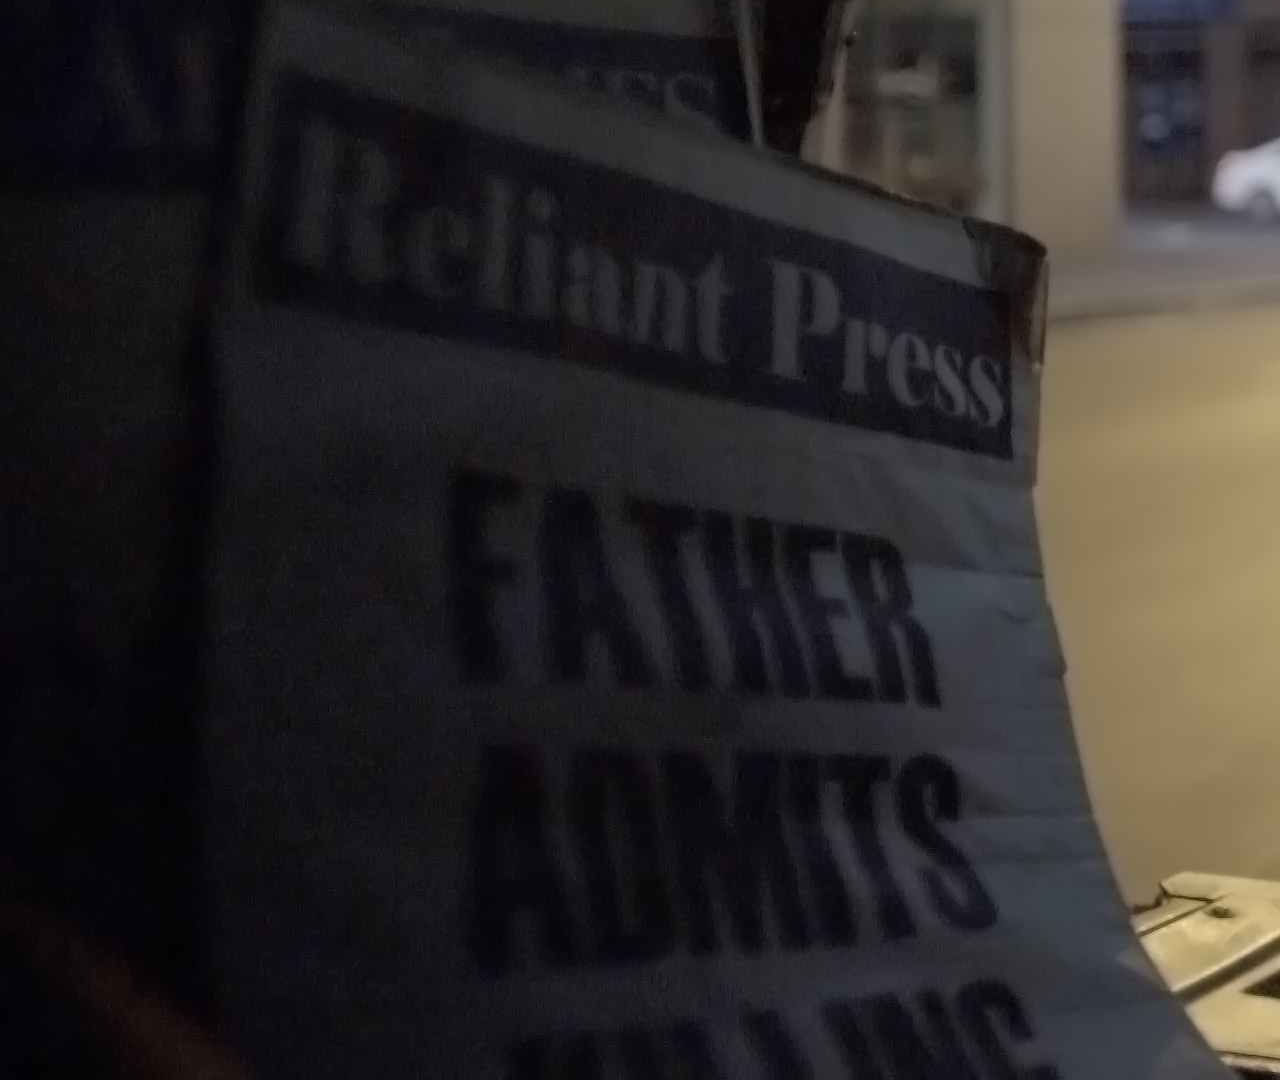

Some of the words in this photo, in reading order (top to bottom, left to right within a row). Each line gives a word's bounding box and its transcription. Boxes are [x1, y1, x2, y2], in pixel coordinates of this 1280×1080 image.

[272, 123, 731, 365] Reliant
[762, 257, 1004, 429] Press
[450, 469, 942, 708] FATHER
[466, 744, 998, 975] ADMITS
